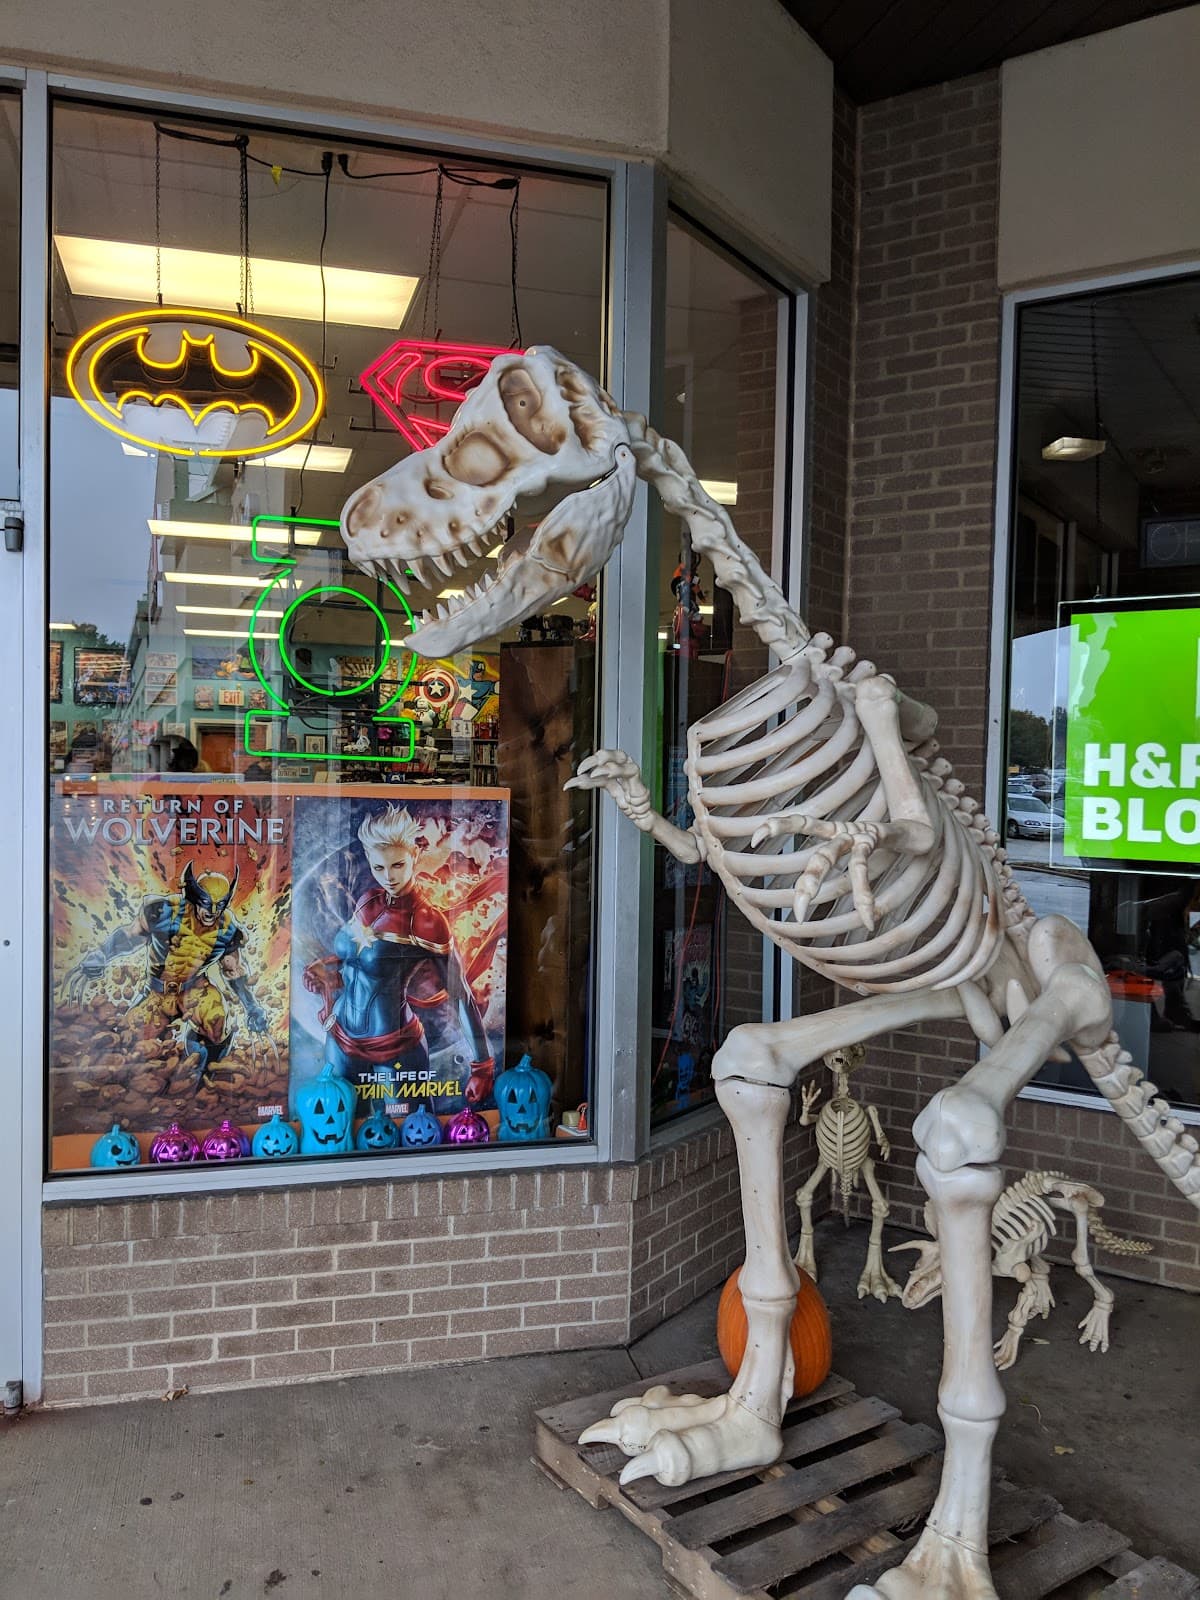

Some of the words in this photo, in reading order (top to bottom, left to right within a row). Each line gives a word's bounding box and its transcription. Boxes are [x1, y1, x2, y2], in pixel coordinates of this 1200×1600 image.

[223, 691, 241, 704] EXIT
[103, 799, 201, 814] RETURN
[214, 799, 244, 814] OF
[1082, 796, 1200, 845] BLO
[62, 817, 284, 846] WOLVERINE
[358, 1072, 386, 1083] THE
[389, 1071, 416, 1082] LIFE
[418, 1070, 437, 1081] OF
[396, 1081, 462, 1098] MARVEL
[257, 1105, 284, 1117] MARVEL
[385, 1103, 410, 1114] MARVEL
